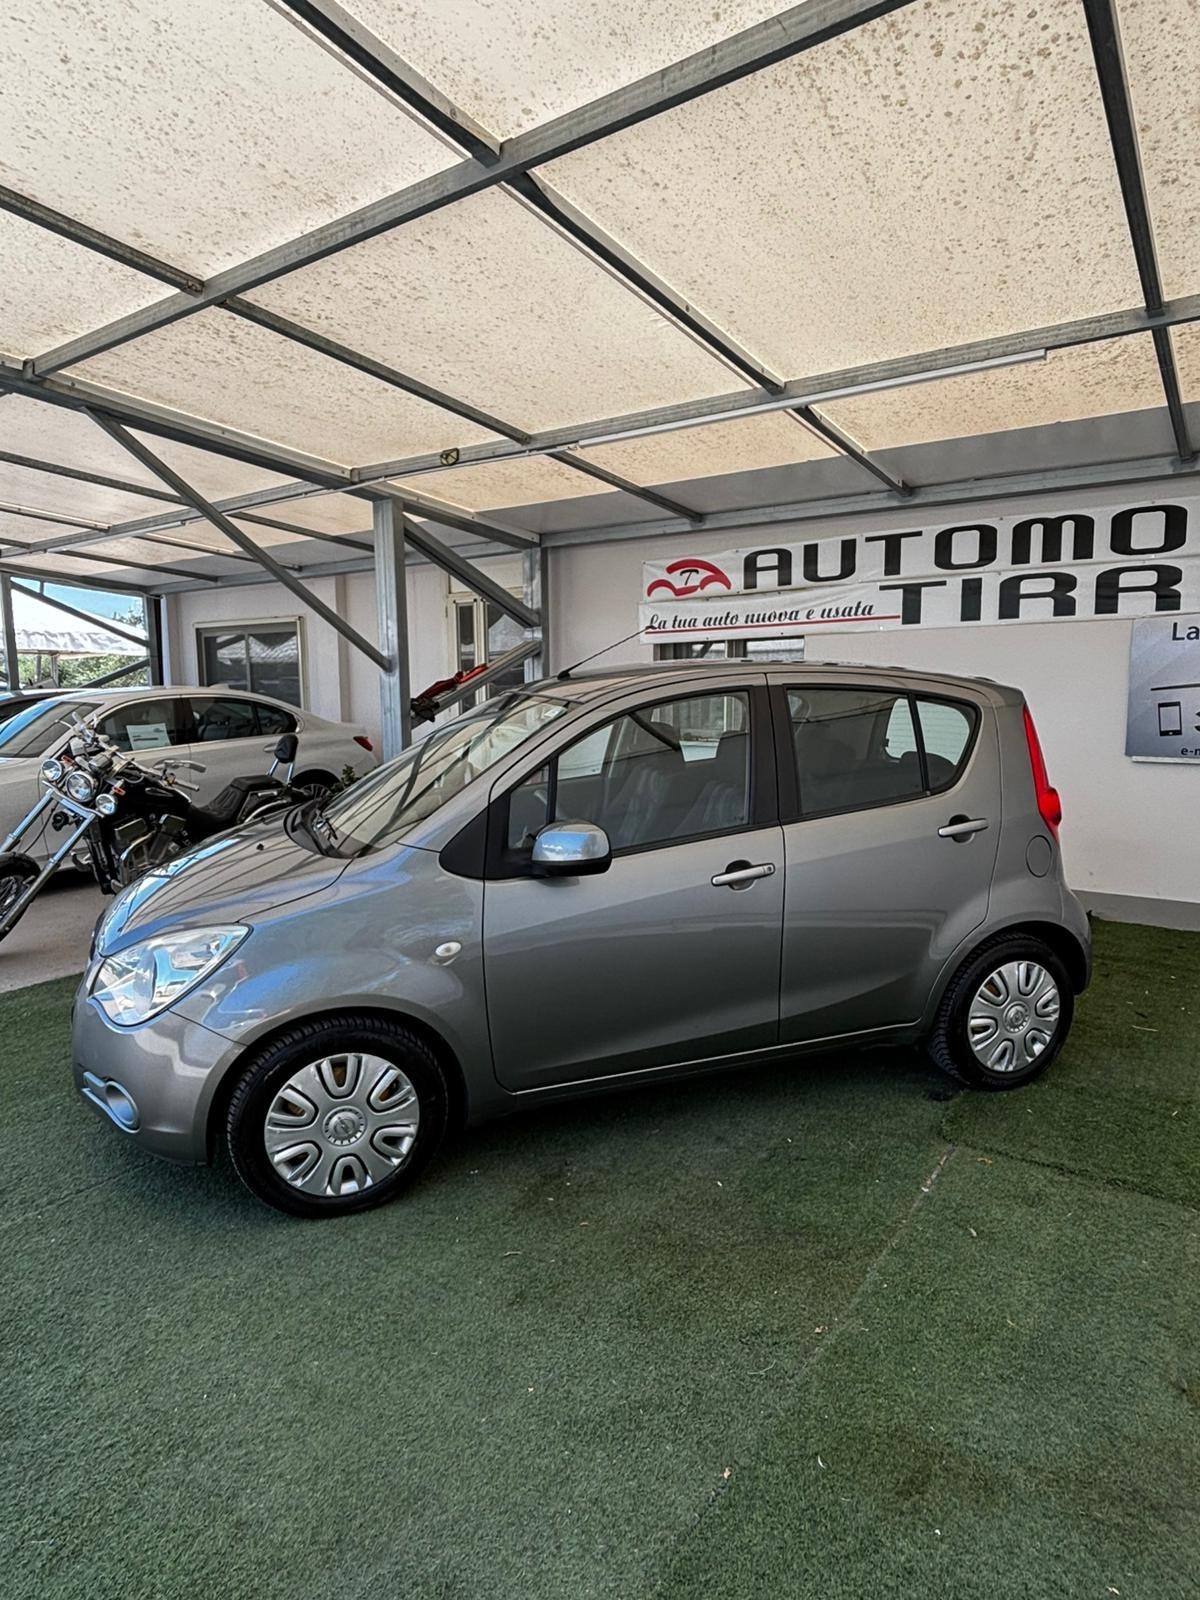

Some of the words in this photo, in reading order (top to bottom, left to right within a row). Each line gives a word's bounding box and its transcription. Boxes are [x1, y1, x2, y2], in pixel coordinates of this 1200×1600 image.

[743, 504, 1188, 590] AUTOMO
[648, 613, 667, 631] La
[671, 614, 698, 629] tua
[702, 611, 739, 627] auto
[744, 607, 800, 625] nuova
[805, 607, 815, 620] e
[820, 600, 875, 619] usata
[879, 564, 1183, 625] TIRR
[1172, 622, 1200, 641] La
